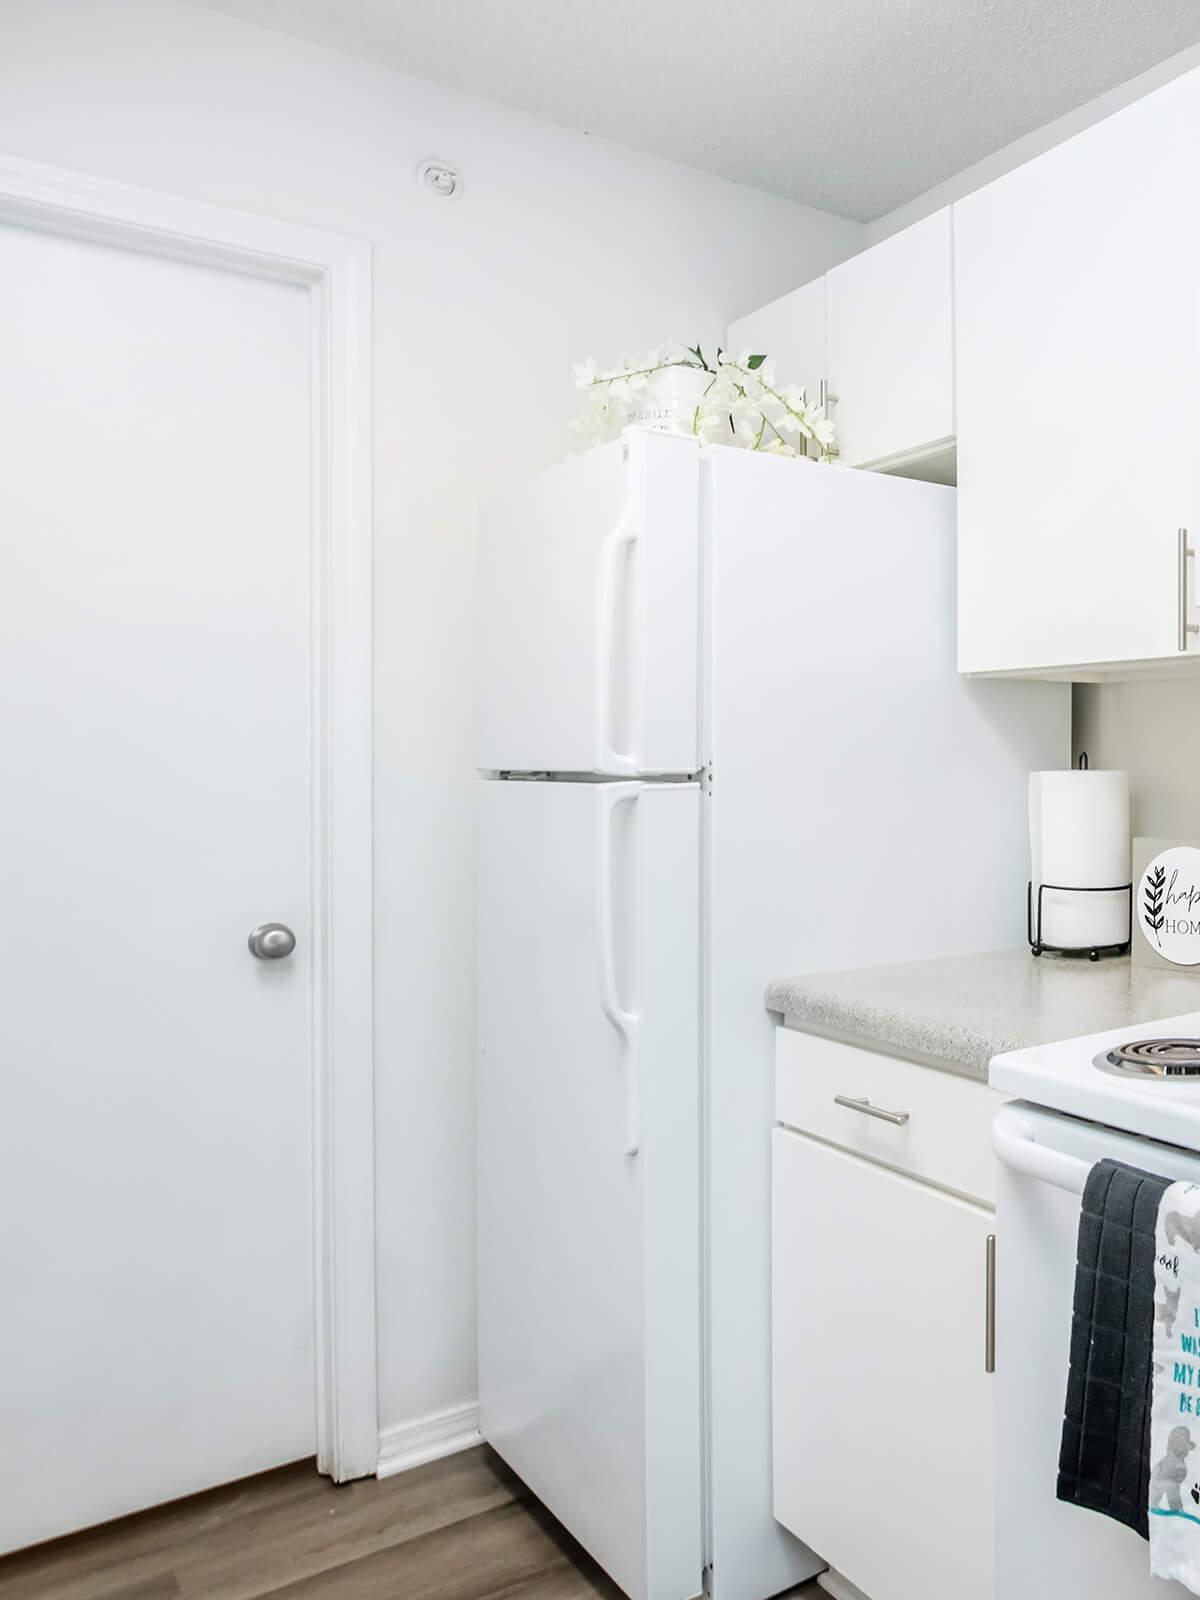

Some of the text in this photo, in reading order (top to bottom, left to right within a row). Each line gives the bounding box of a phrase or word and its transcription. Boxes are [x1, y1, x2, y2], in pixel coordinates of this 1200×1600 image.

[1157, 1254, 1180, 1279] oof
[1173, 1361, 1194, 1386] MY
[1180, 1391, 1193, 1413] BE
